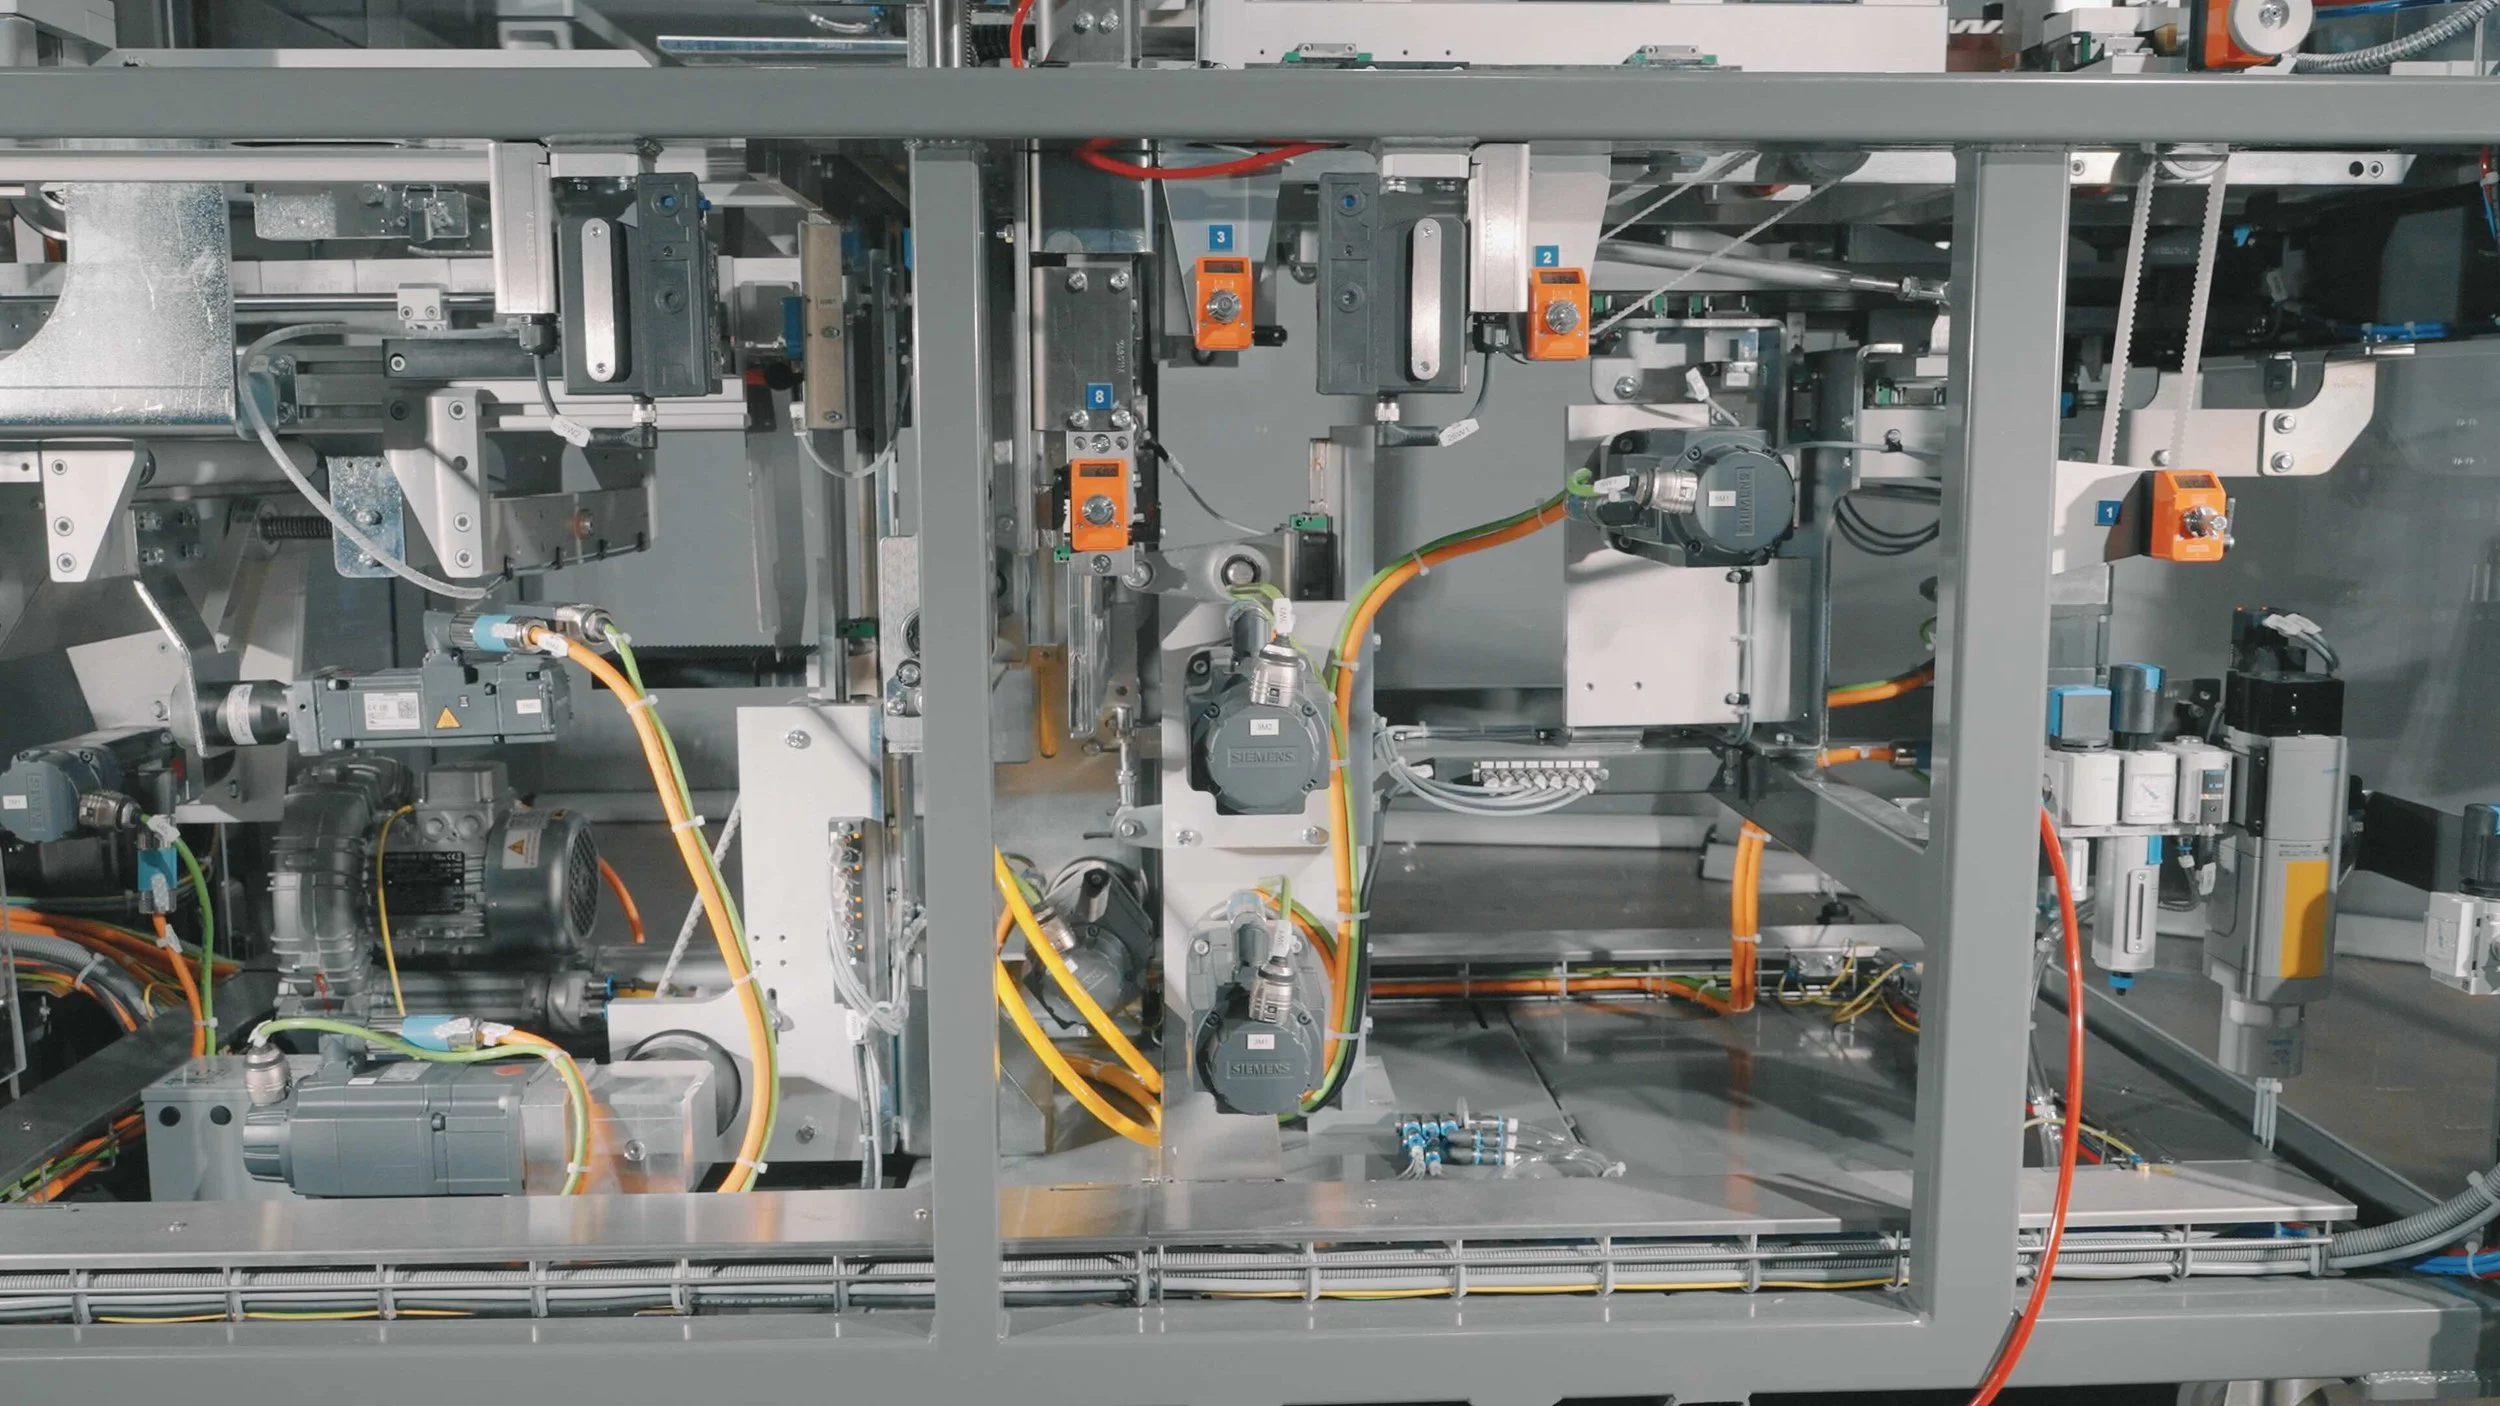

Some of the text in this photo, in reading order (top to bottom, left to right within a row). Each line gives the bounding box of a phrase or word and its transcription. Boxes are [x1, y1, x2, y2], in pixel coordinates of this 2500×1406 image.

[1215, 230, 1225, 244] 3
[1543, 251, 1553, 264] 2
[1095, 389, 1105, 403] 8
[1739, 471, 1751, 534] SIEMENS
[2106, 506, 2114, 519] 1
[1230, 751, 1295, 764] SIEMENS
[1230, 1063, 1292, 1075] SIEMENS
